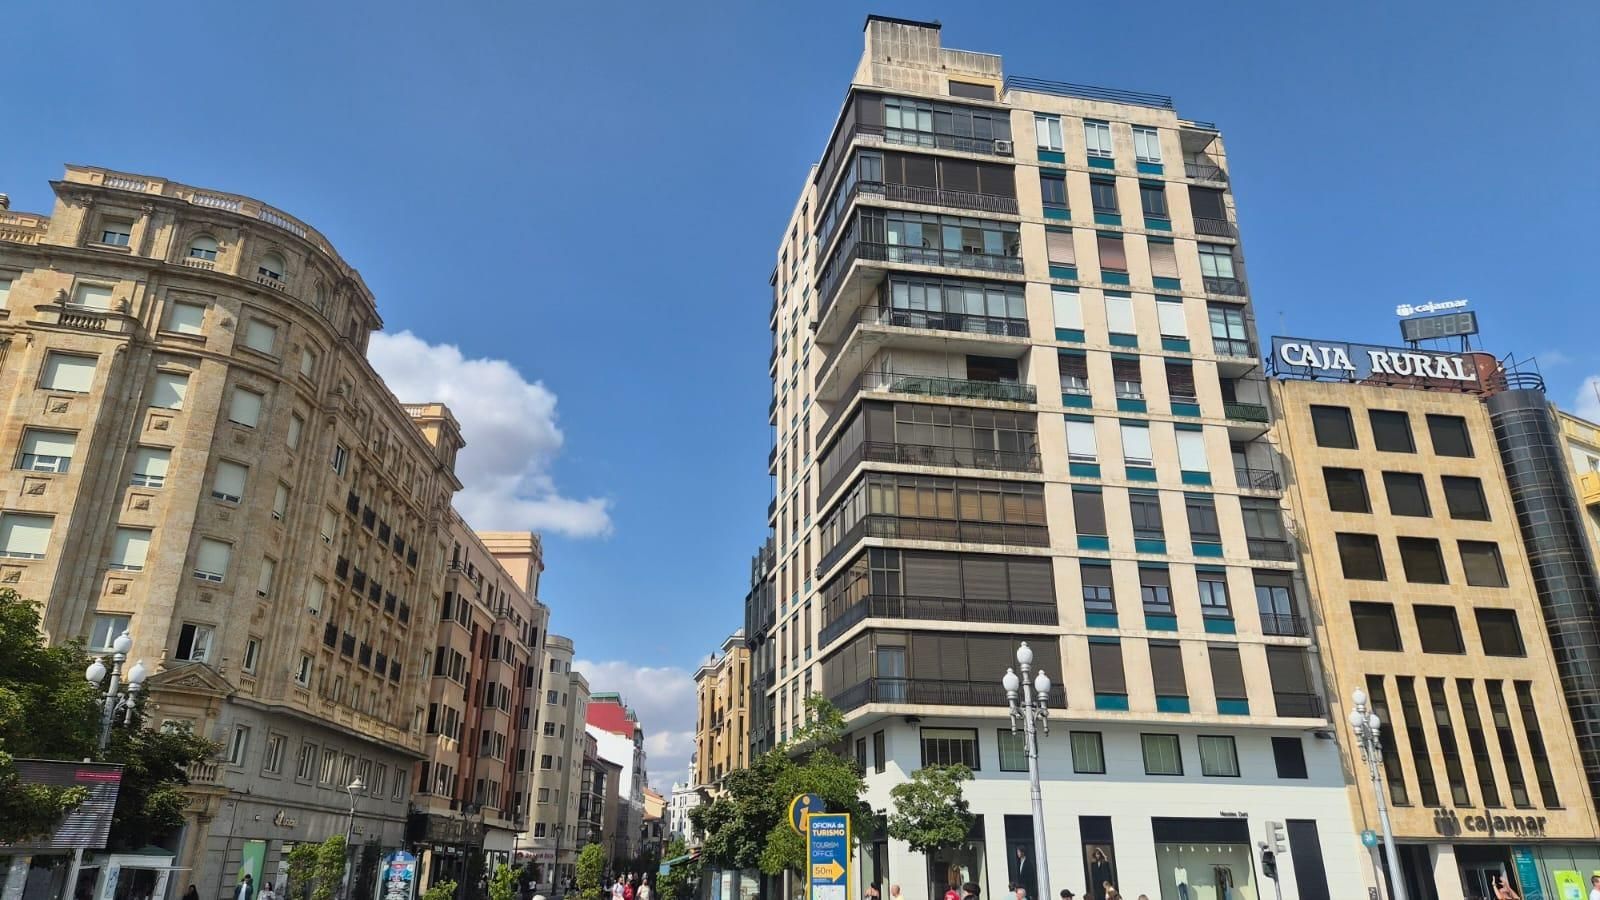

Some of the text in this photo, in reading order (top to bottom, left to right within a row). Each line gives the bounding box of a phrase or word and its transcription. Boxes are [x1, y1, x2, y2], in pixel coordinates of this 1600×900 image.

[1414, 299, 1468, 313] cajamar
[1280, 343, 1476, 381] CAJA RURAL
[1464, 809, 1546, 837] cajamar
[812, 829, 845, 837] TURISMO
[812, 841, 839, 849] TOURISM
[815, 867, 833, 875] 50m
